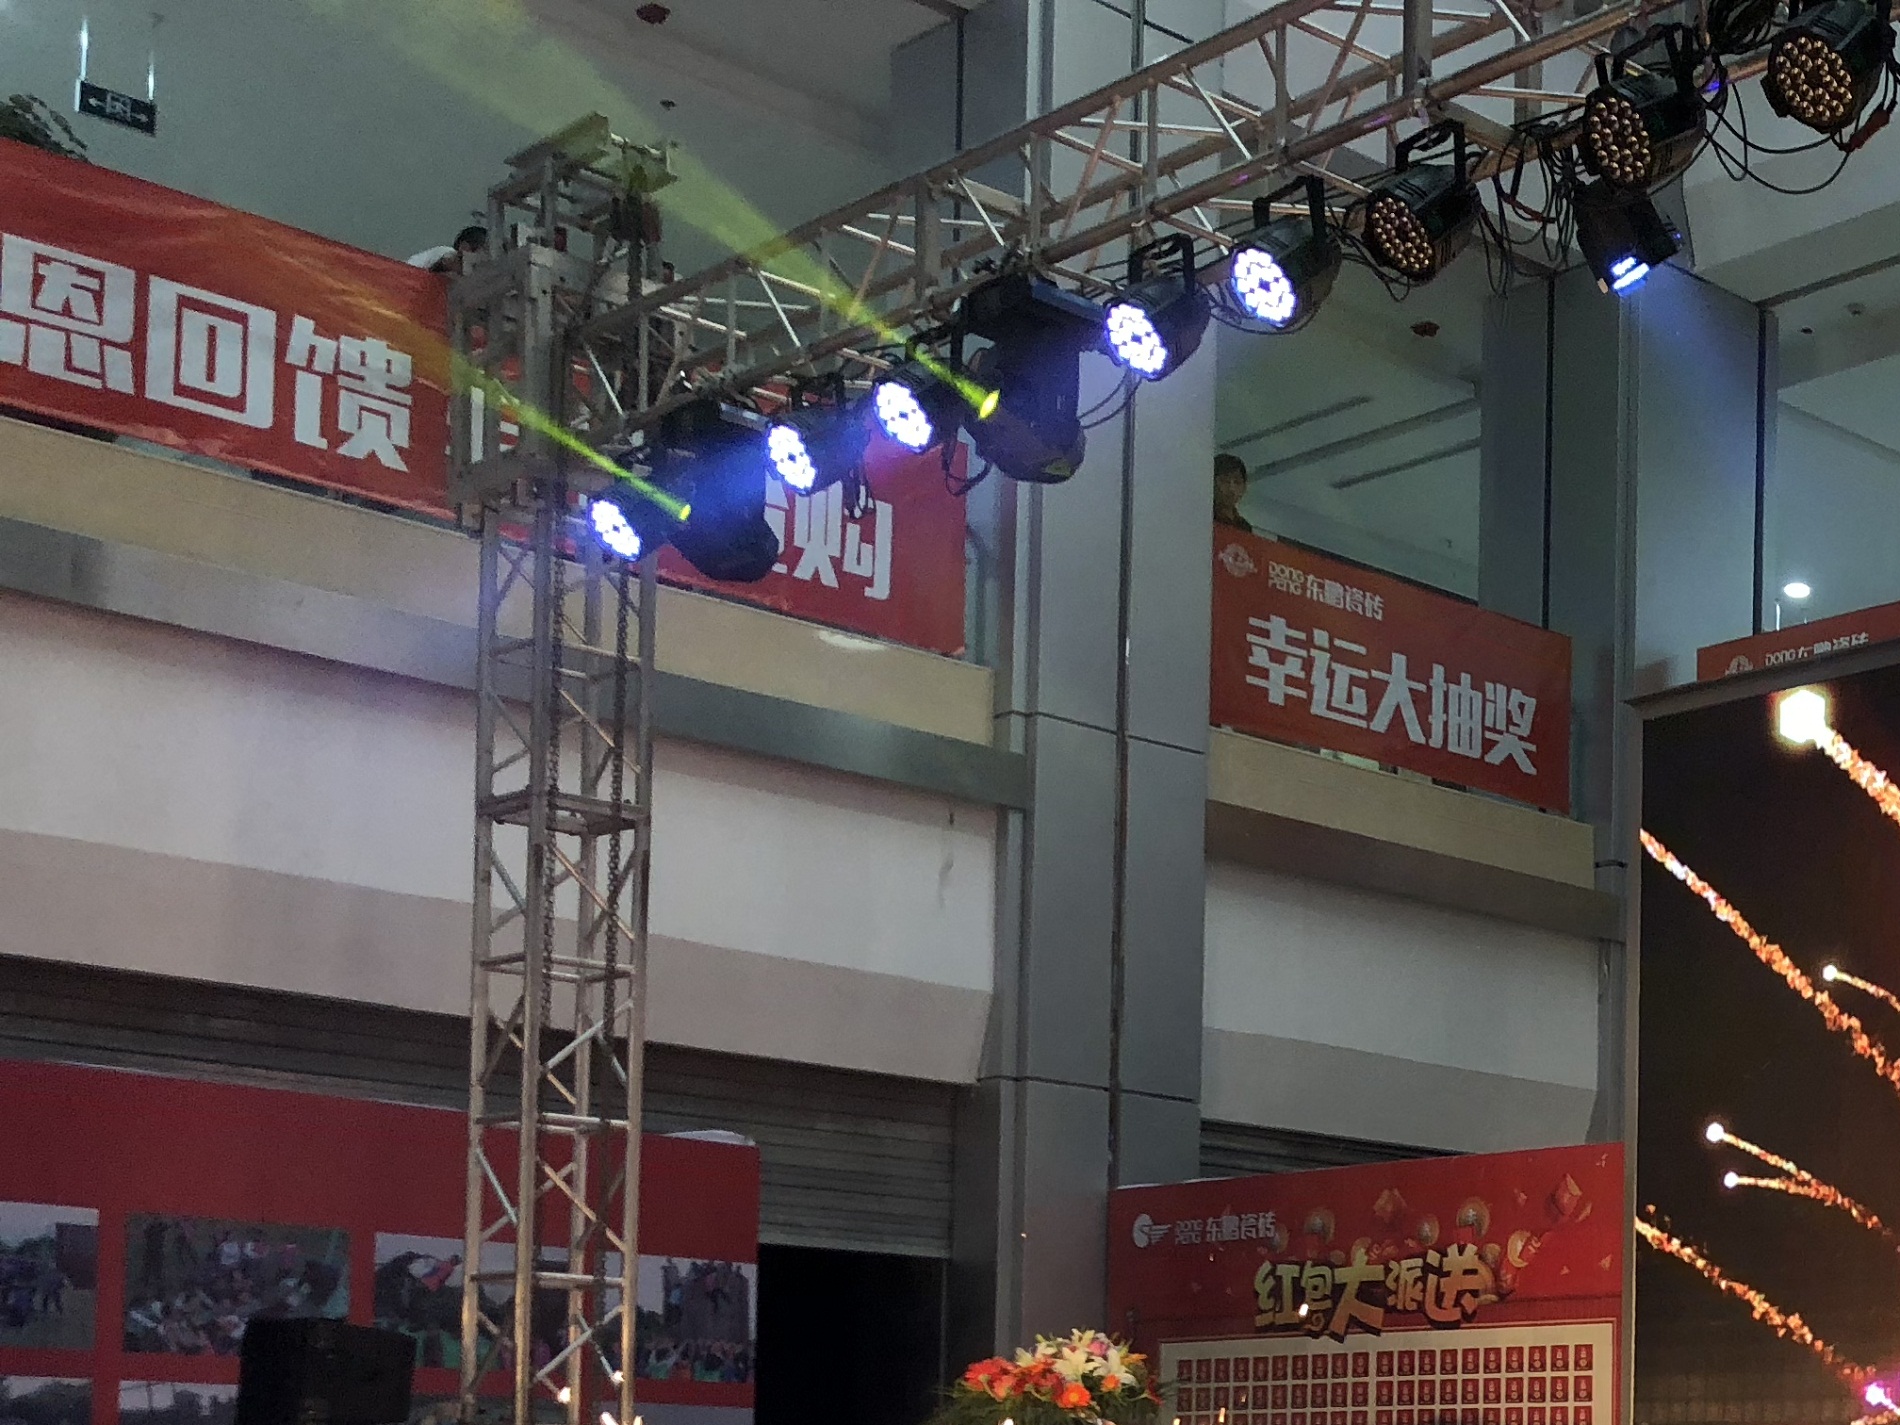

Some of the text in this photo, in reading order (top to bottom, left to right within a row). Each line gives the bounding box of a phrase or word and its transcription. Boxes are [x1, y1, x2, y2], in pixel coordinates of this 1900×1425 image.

[1306, 574, 1385, 621] 东鹏瓷砖
[1245, 614, 1538, 776] 幸运大抽奖
[1206, 1211, 1277, 1243] 东鹏瓷砖
[1254, 1243, 1488, 1338] 红包大派送
